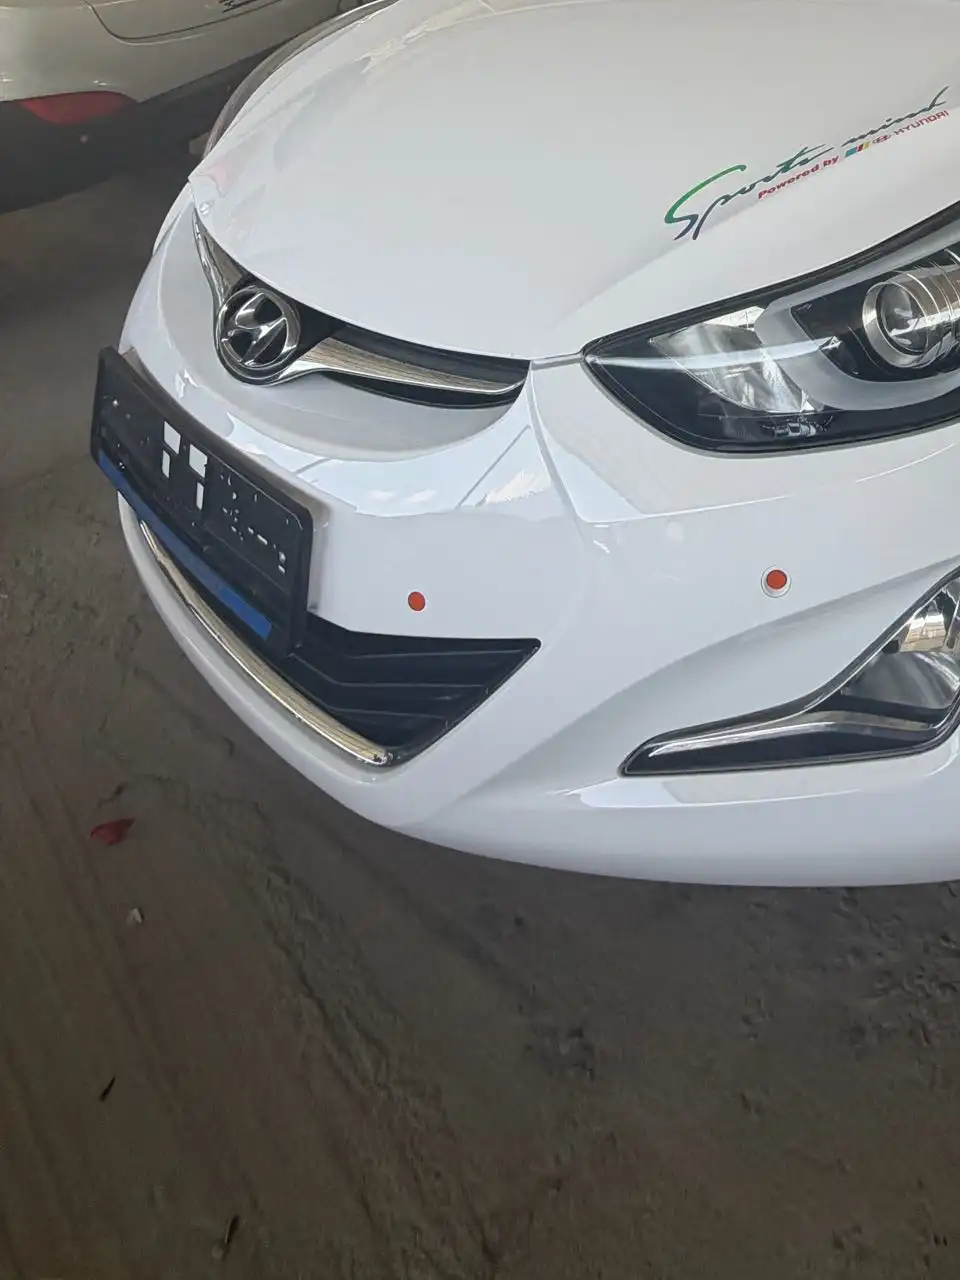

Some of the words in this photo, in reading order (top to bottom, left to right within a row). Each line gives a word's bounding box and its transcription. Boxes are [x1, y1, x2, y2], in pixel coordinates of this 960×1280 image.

[757, 163, 820, 200] Powered
[822, 155, 840, 170] by
[893, 109, 950, 136] HYUNDAI
